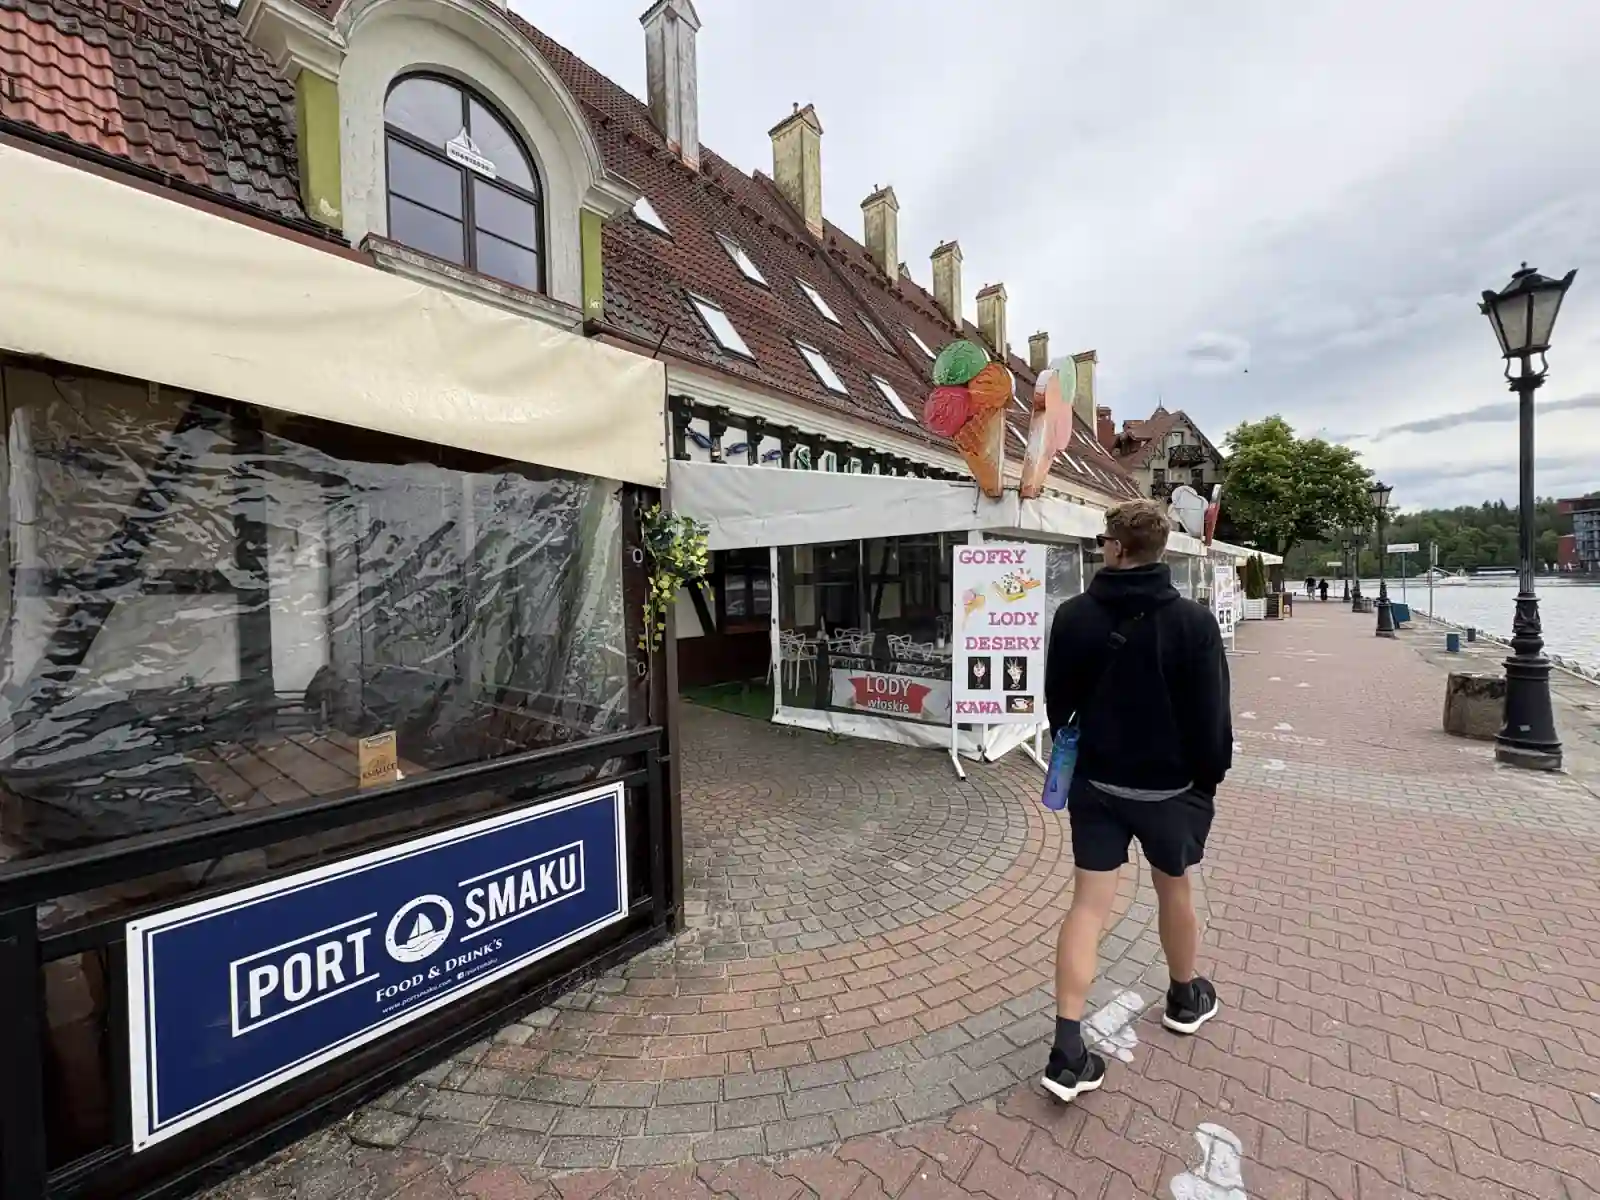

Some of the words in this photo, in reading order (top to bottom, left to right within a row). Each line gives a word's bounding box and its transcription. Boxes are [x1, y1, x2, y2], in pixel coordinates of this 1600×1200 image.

[959, 549, 1026, 564] GOFRY
[988, 612, 1039, 626] LODY
[965, 637, 1042, 650] DESERY
[866, 674, 912, 697] LODY
[956, 701, 1003, 714] KAWA
[248, 928, 372, 1018] PORT
[465, 853, 577, 929] SMAKU
[427, 965, 441, 979] &
